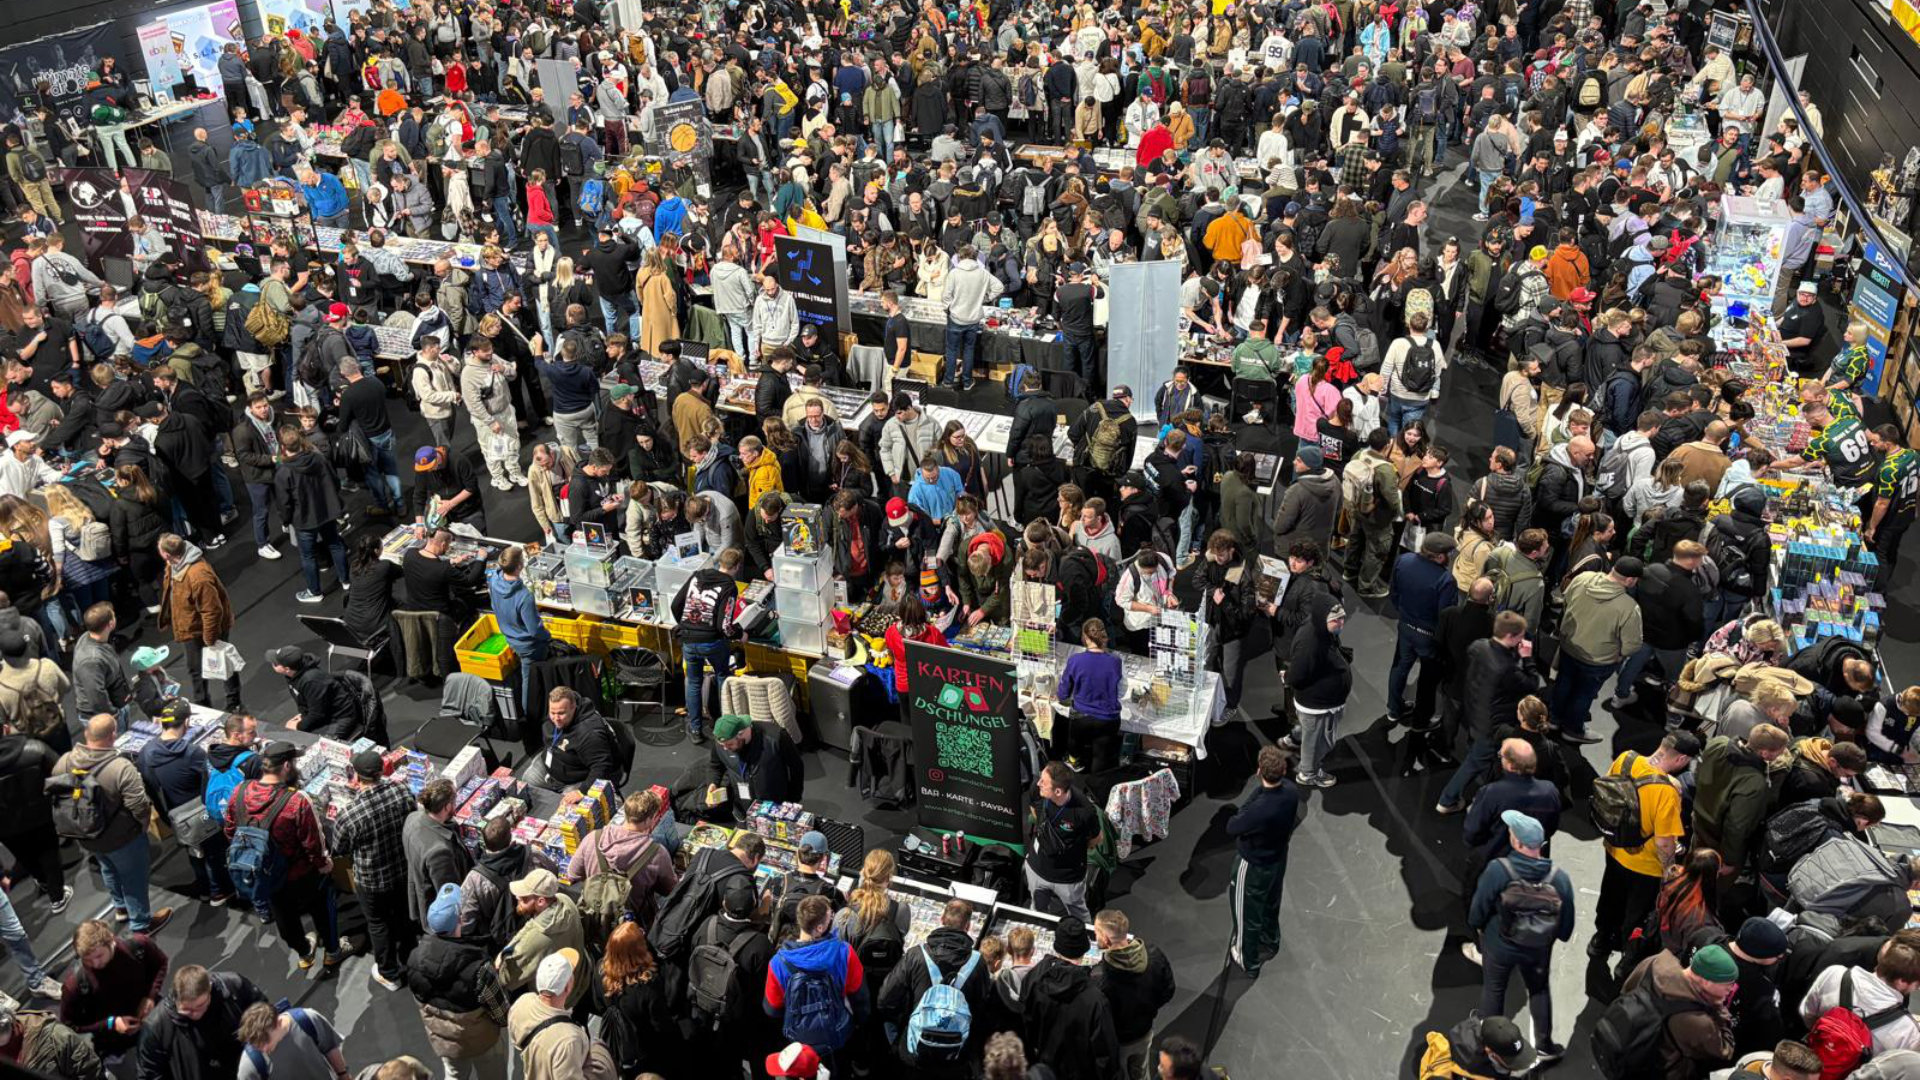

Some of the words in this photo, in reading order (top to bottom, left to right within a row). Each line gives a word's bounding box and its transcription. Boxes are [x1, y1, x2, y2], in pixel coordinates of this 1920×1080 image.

[1268, 46, 1283, 58] 99
[1840, 429, 1869, 463] 69
[917, 661, 1003, 693] KARTEN
[915, 697, 1011, 728] DSCHUNGEL
[920, 786, 940, 797] BAR
[945, 792, 974, 805] KARTE
[980, 801, 1015, 816] PAYPAL
